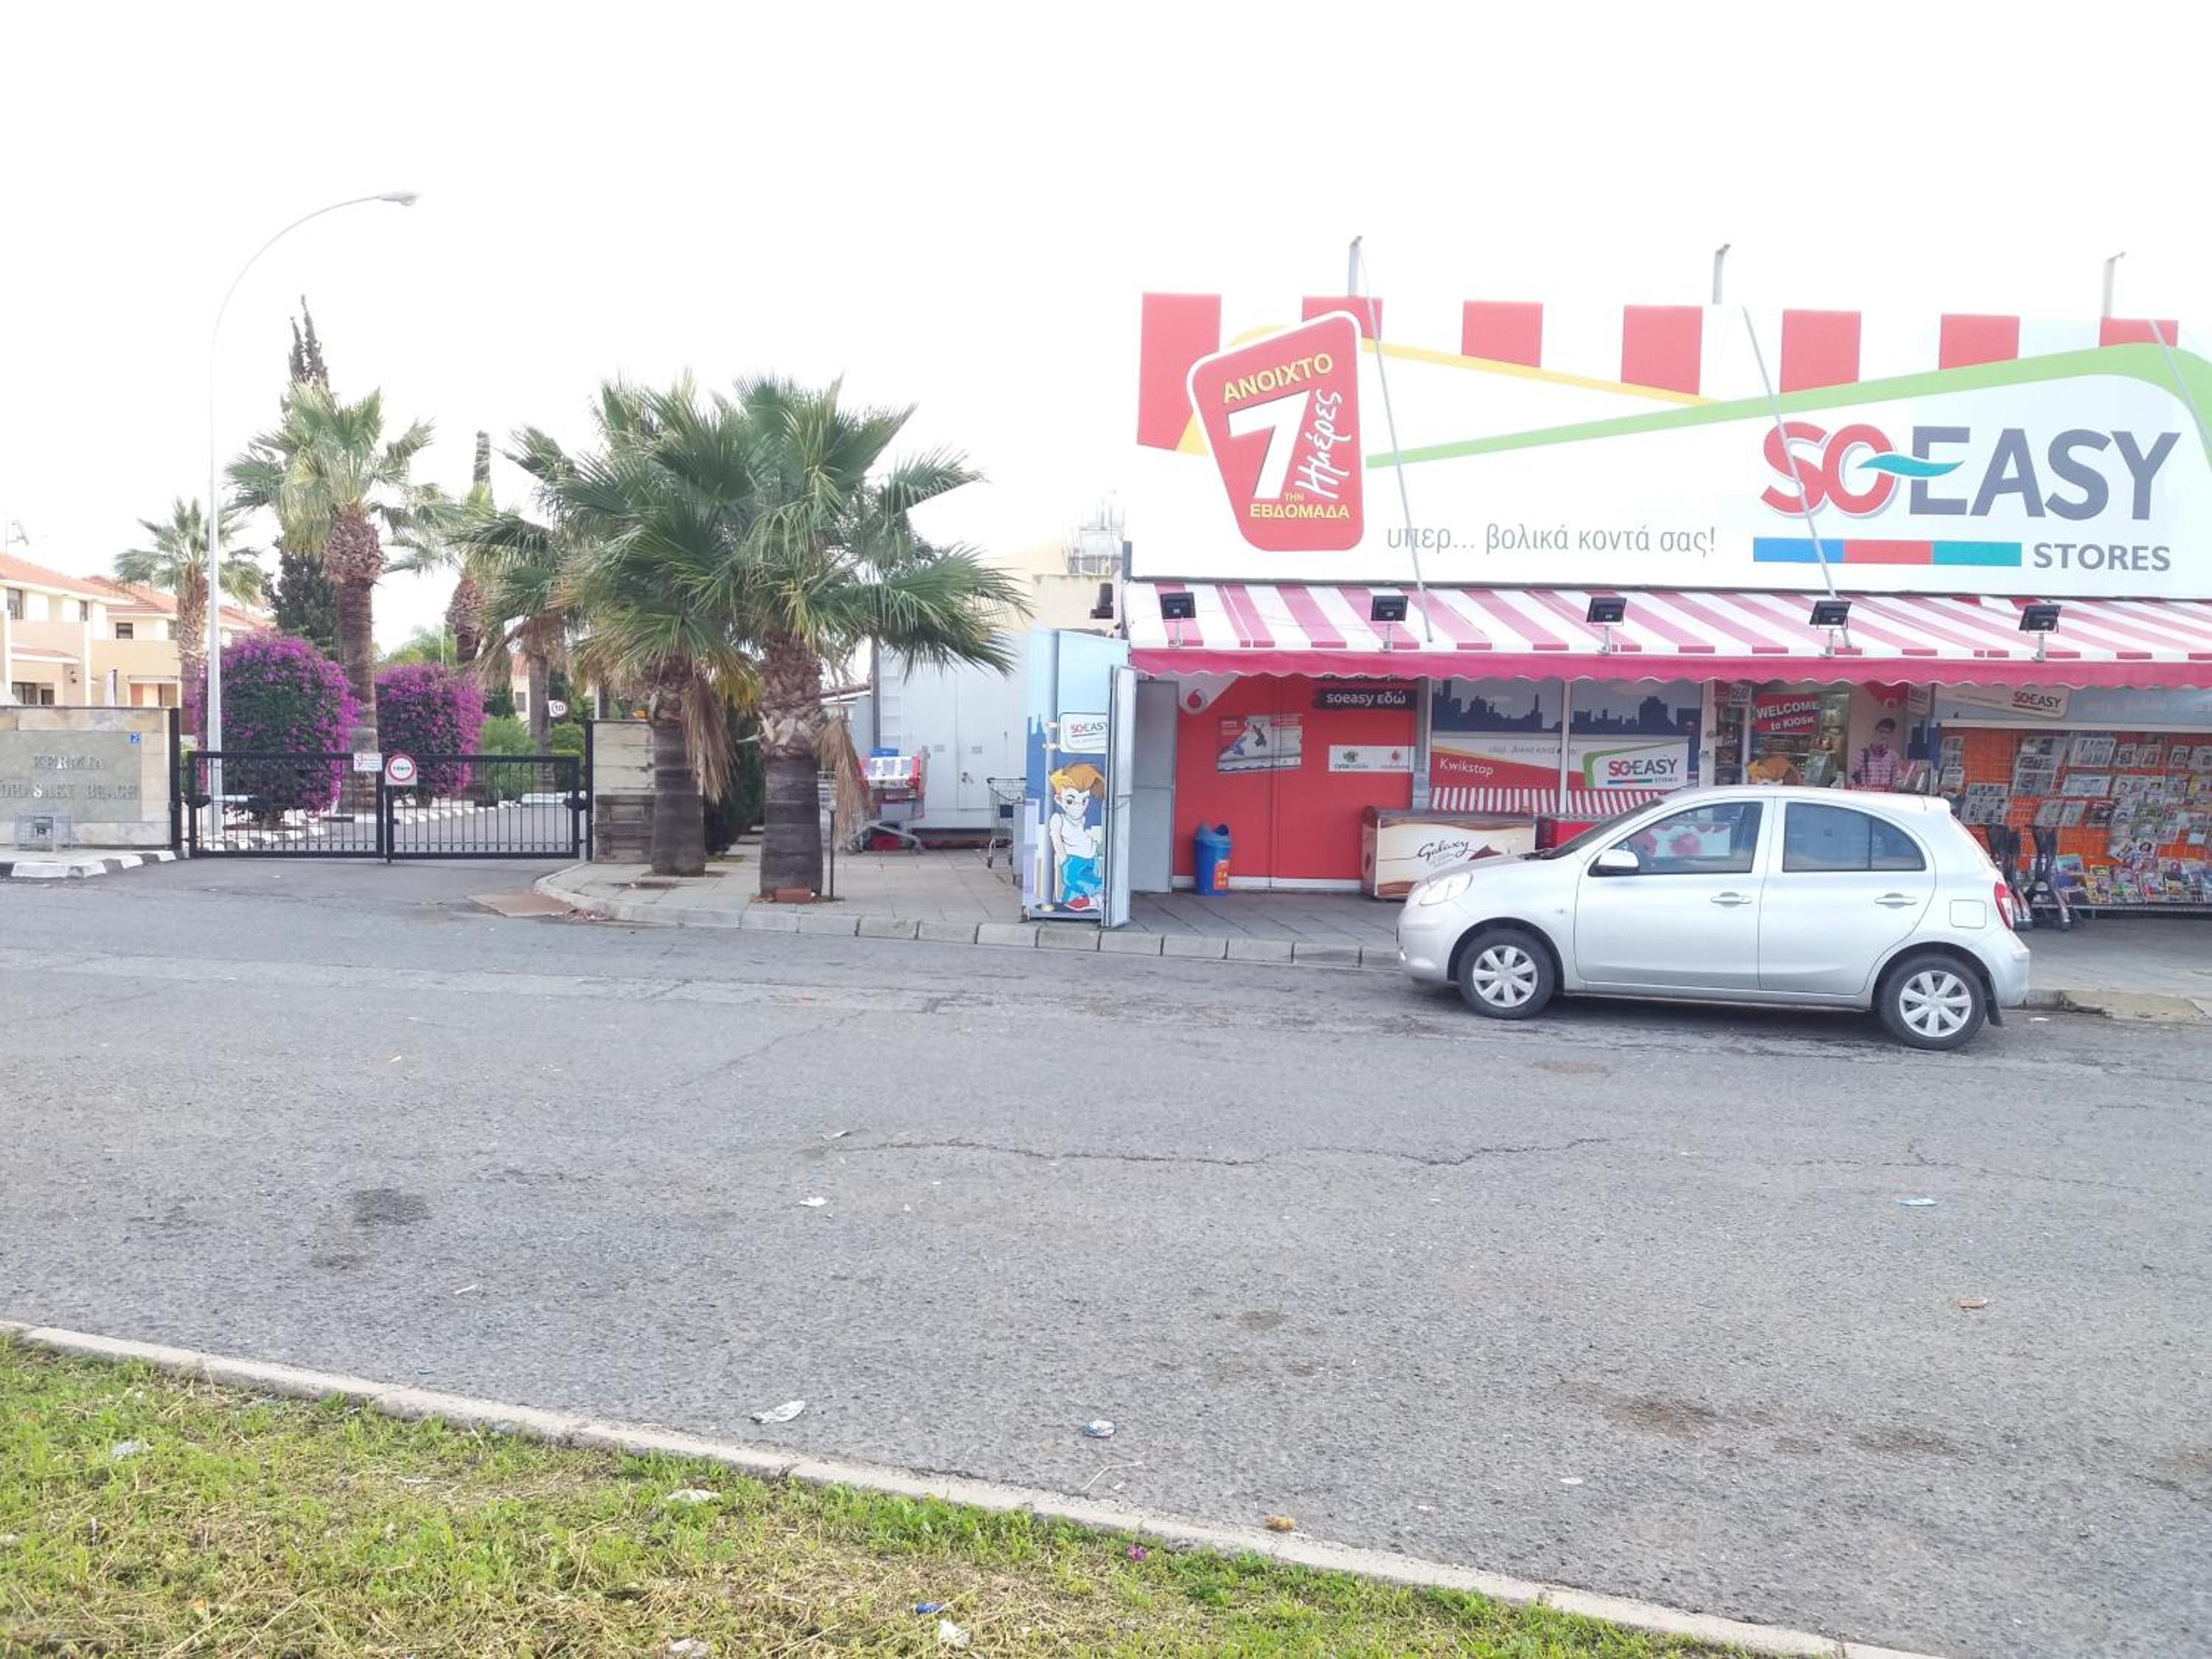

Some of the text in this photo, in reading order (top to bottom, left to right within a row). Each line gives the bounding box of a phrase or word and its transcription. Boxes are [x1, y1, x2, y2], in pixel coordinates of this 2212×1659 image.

[1223, 353, 1334, 403] ΑΝΟΙΧΤΟ
[1227, 390, 1310, 499] 7
[1295, 389, 1352, 500] Ημέρες
[1760, 421, 2181, 521] SOEASY
[1284, 493, 1305, 502] ΤΗΝ
[1250, 503, 1351, 520] ΕΒΔΟΜΑΔΑ
[1486, 523, 1568, 554] βολικά
[1579, 524, 1650, 551] κοντά
[1660, 526, 1715, 558] σας!
[2033, 543, 2171, 572] STORES
[1326, 692, 1374, 707] soeasy
[1757, 700, 1820, 720] WELCOME
[2013, 690, 2062, 709] SOEASY
[1440, 757, 1494, 778] Kwikstop
[1608, 758, 1677, 776] SOEASY
[1417, 840, 1470, 861] Galaxy
